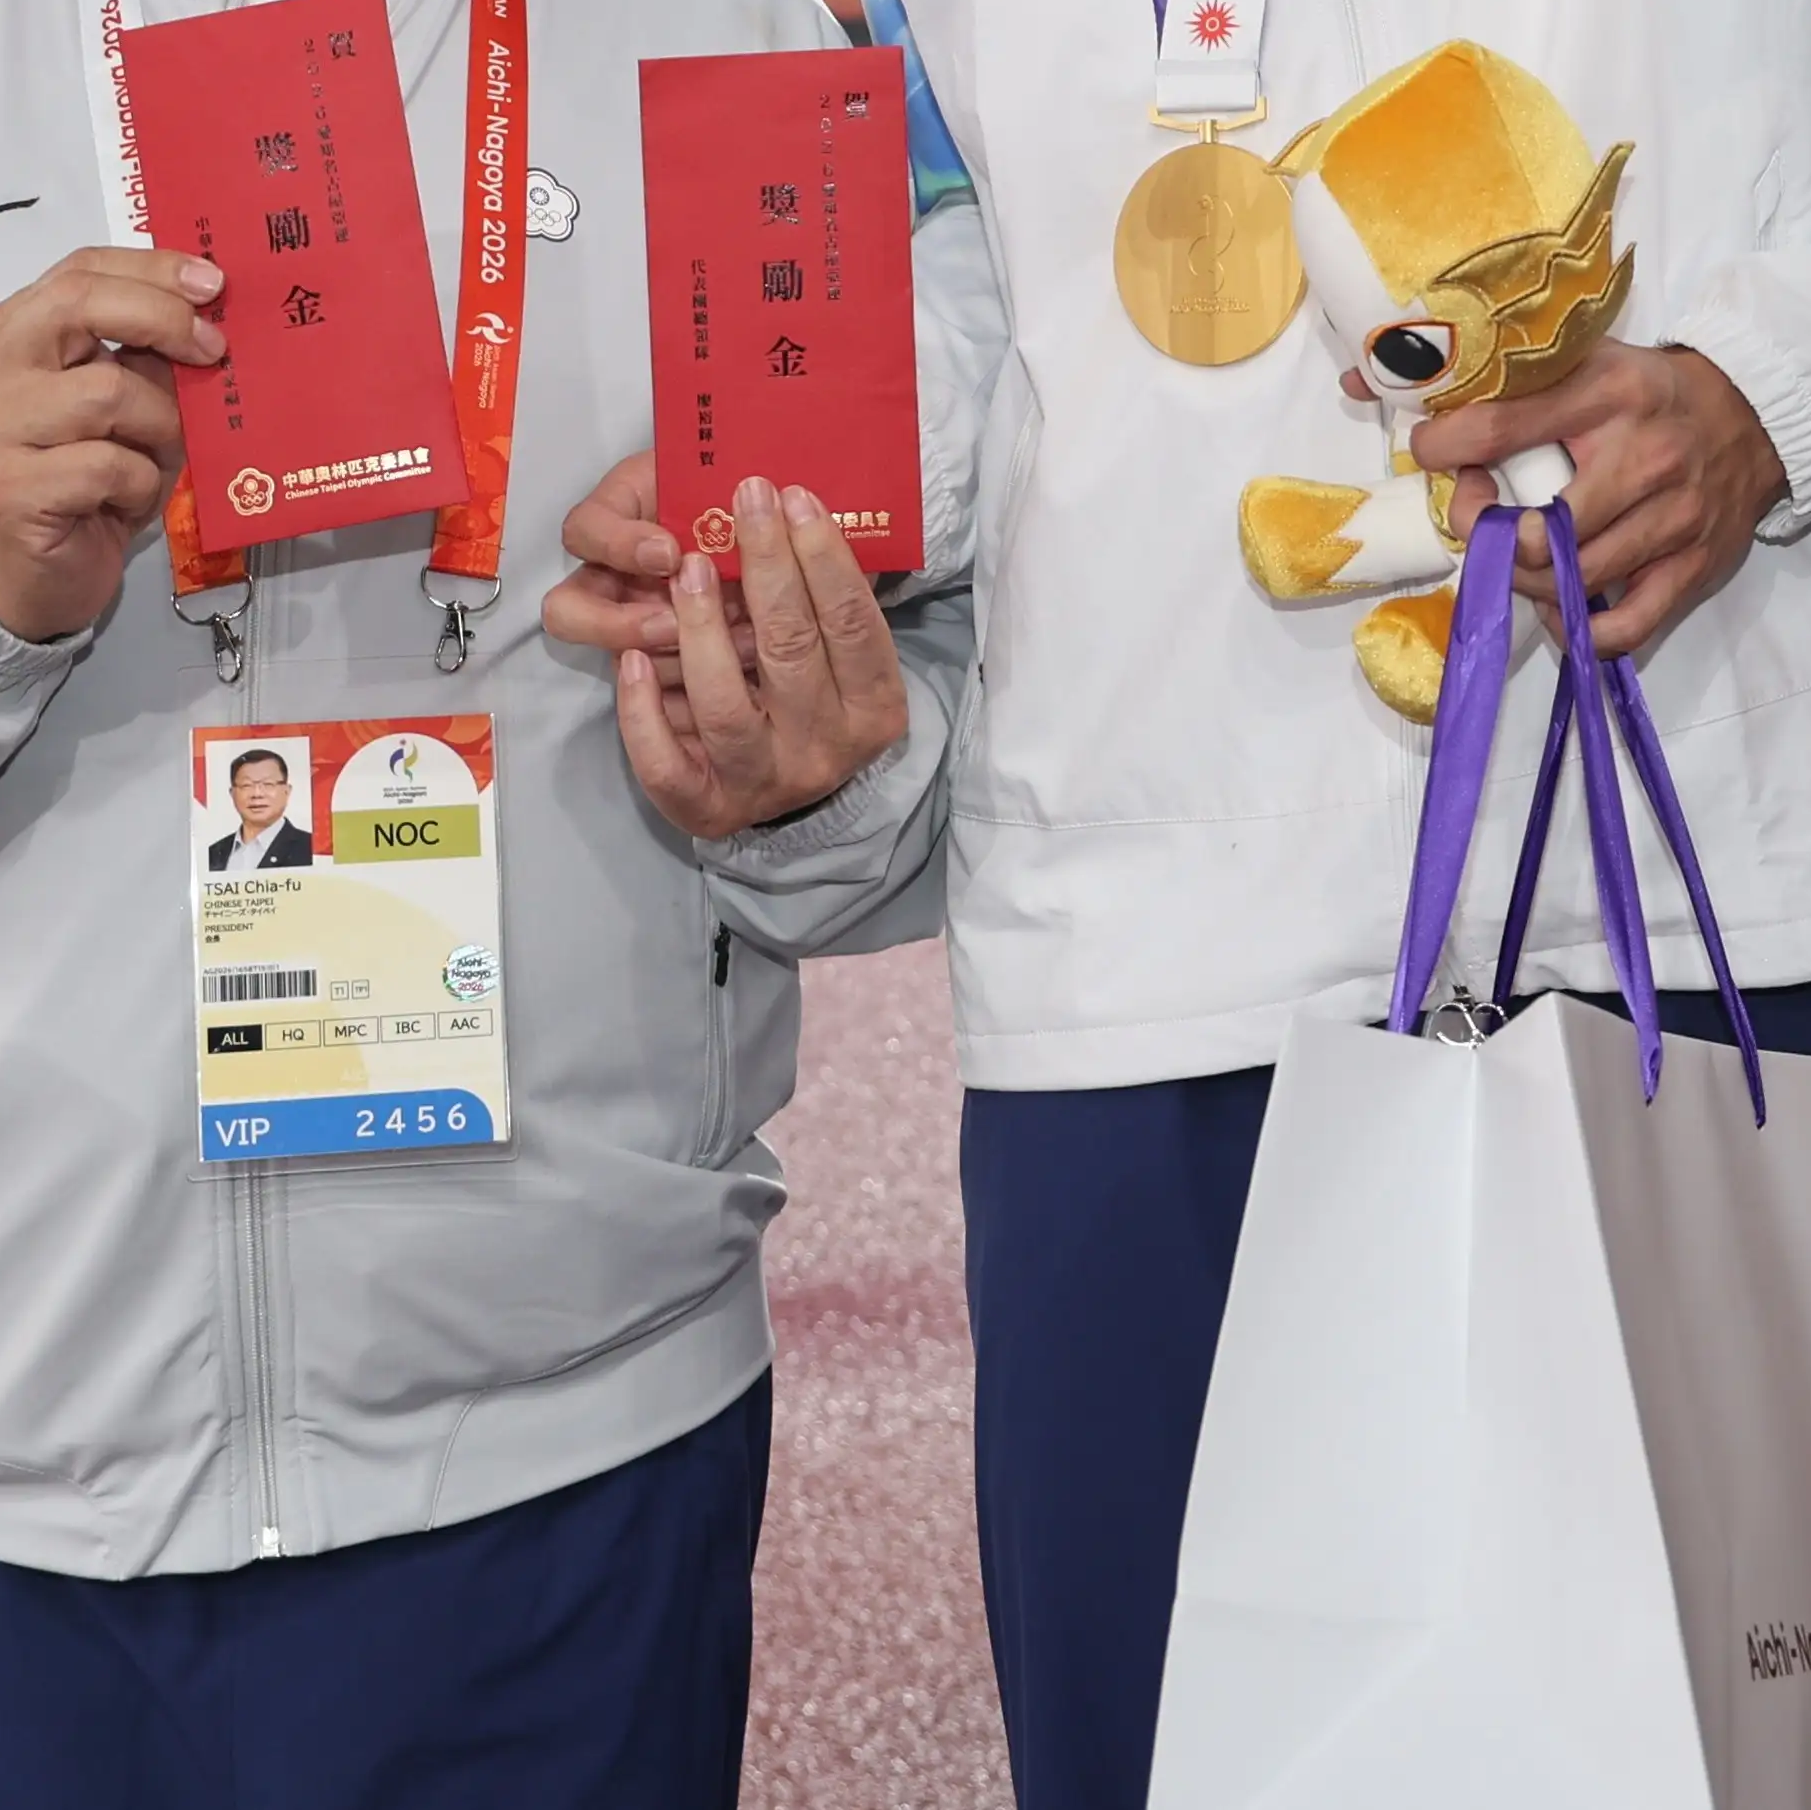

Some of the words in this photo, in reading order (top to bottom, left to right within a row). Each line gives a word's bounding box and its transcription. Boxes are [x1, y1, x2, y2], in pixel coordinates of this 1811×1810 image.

[478, 40, 512, 213] Aichi-Nagoya
[480, 219, 506, 284] 2026
[282, 446, 430, 488] 中華奧林匹克委員會
[285, 486, 319, 500] Chinese
[320, 481, 347, 494] Taipei
[347, 475, 382, 489] Olympic
[383, 466, 432, 482] Committee
[374, 820, 440, 848] NOC
[204, 882, 239, 896] TSAI
[244, 878, 302, 894] Chia-fu
[204, 899, 242, 909] CHINESE
[245, 897, 274, 907] TAIPEI
[204, 923, 254, 933] PRESIDENT
[395, 1020, 422, 1034] IBC
[450, 1016, 480, 1030] AAC
[282, 1028, 305, 1042] HQ
[334, 1024, 367, 1039] MPC
[221, 1033, 249, 1047] ALL
[215, 1118, 270, 1147] VIP
